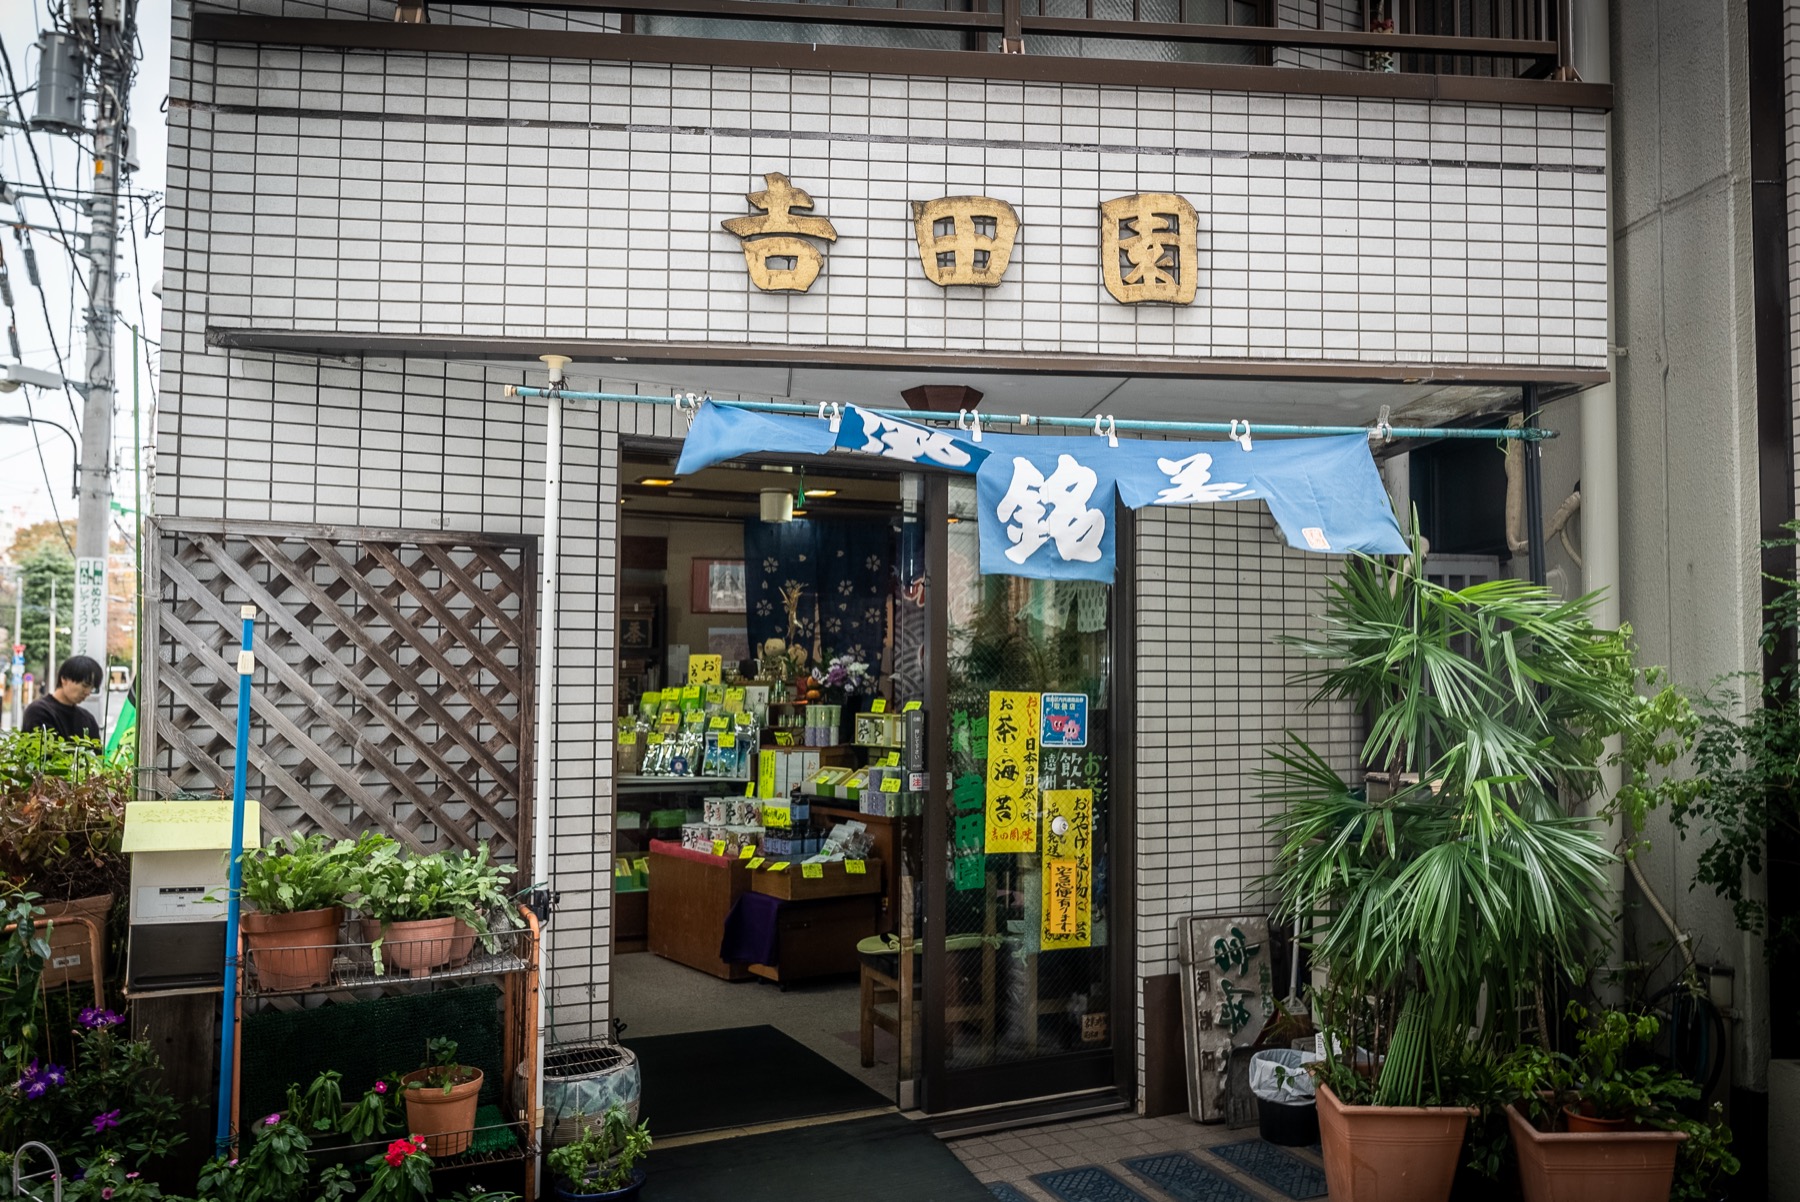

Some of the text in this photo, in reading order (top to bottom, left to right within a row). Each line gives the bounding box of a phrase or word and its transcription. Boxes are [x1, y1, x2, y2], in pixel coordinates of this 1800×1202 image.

[720, 171, 1200, 305] 吉田園
[993, 697, 1019, 823] お茶と海苔
